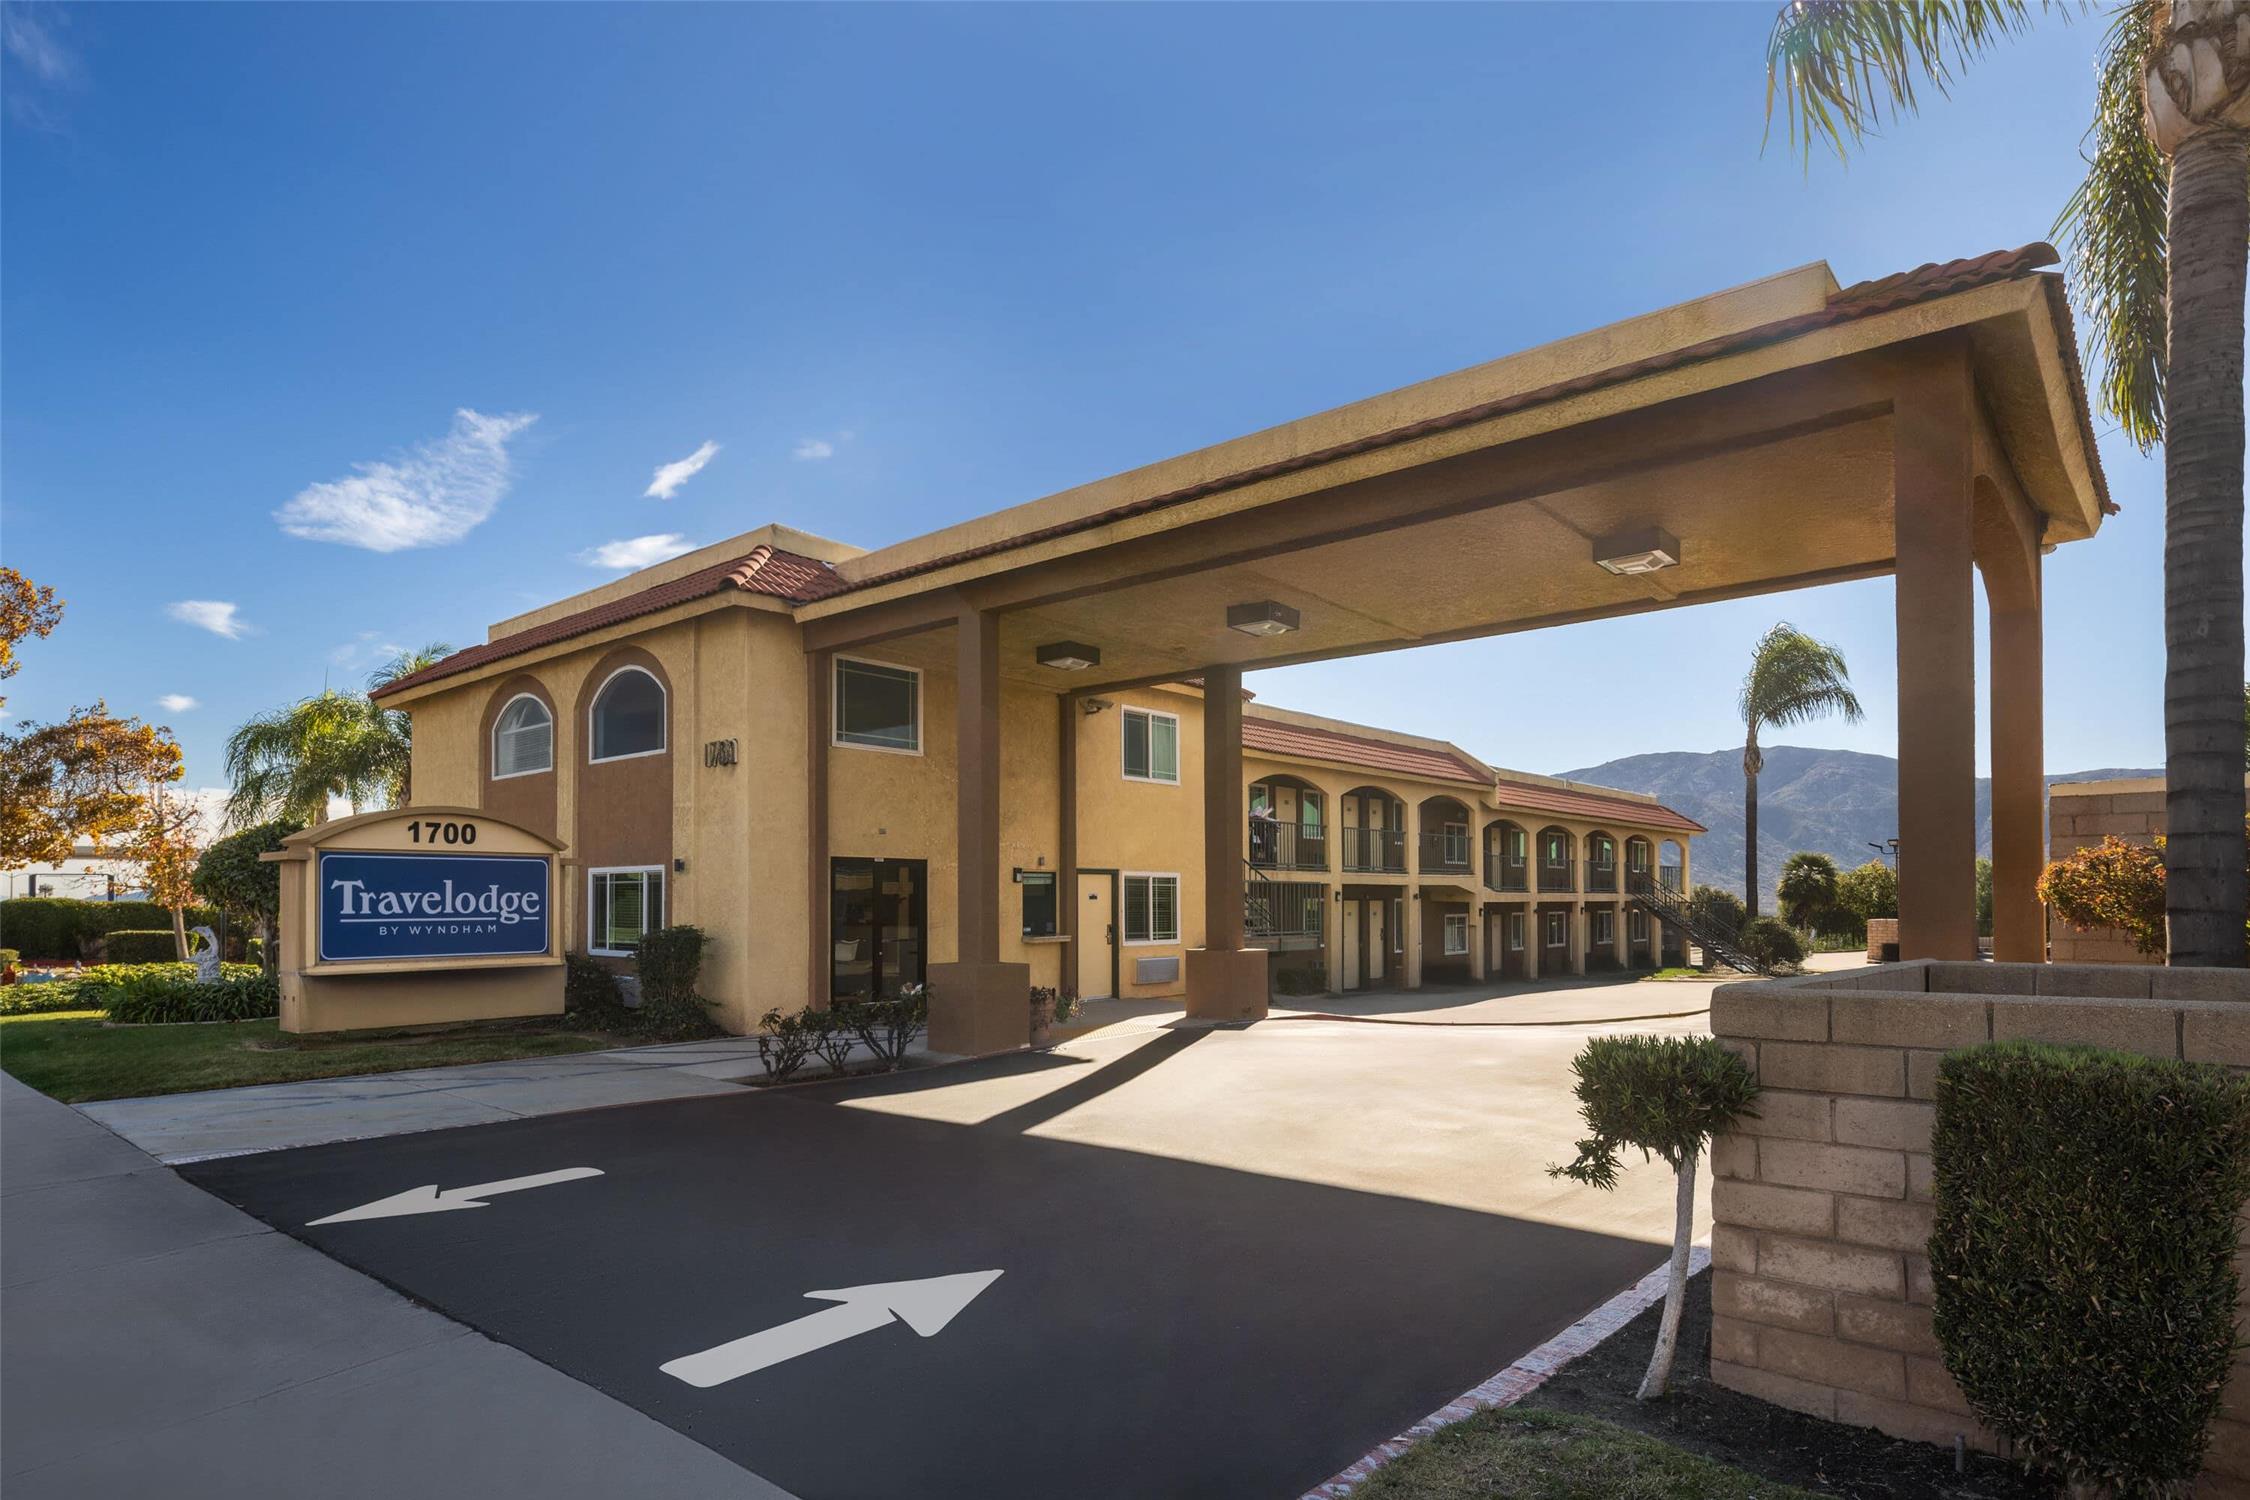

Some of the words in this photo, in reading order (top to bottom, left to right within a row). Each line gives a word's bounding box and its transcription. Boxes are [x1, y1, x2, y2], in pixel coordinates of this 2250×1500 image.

[407, 821, 477, 844] 1700
[330, 879, 540, 924] Travelodge
[379, 926, 399, 936] BY
[409, 924, 497, 935] WYNDHAM
